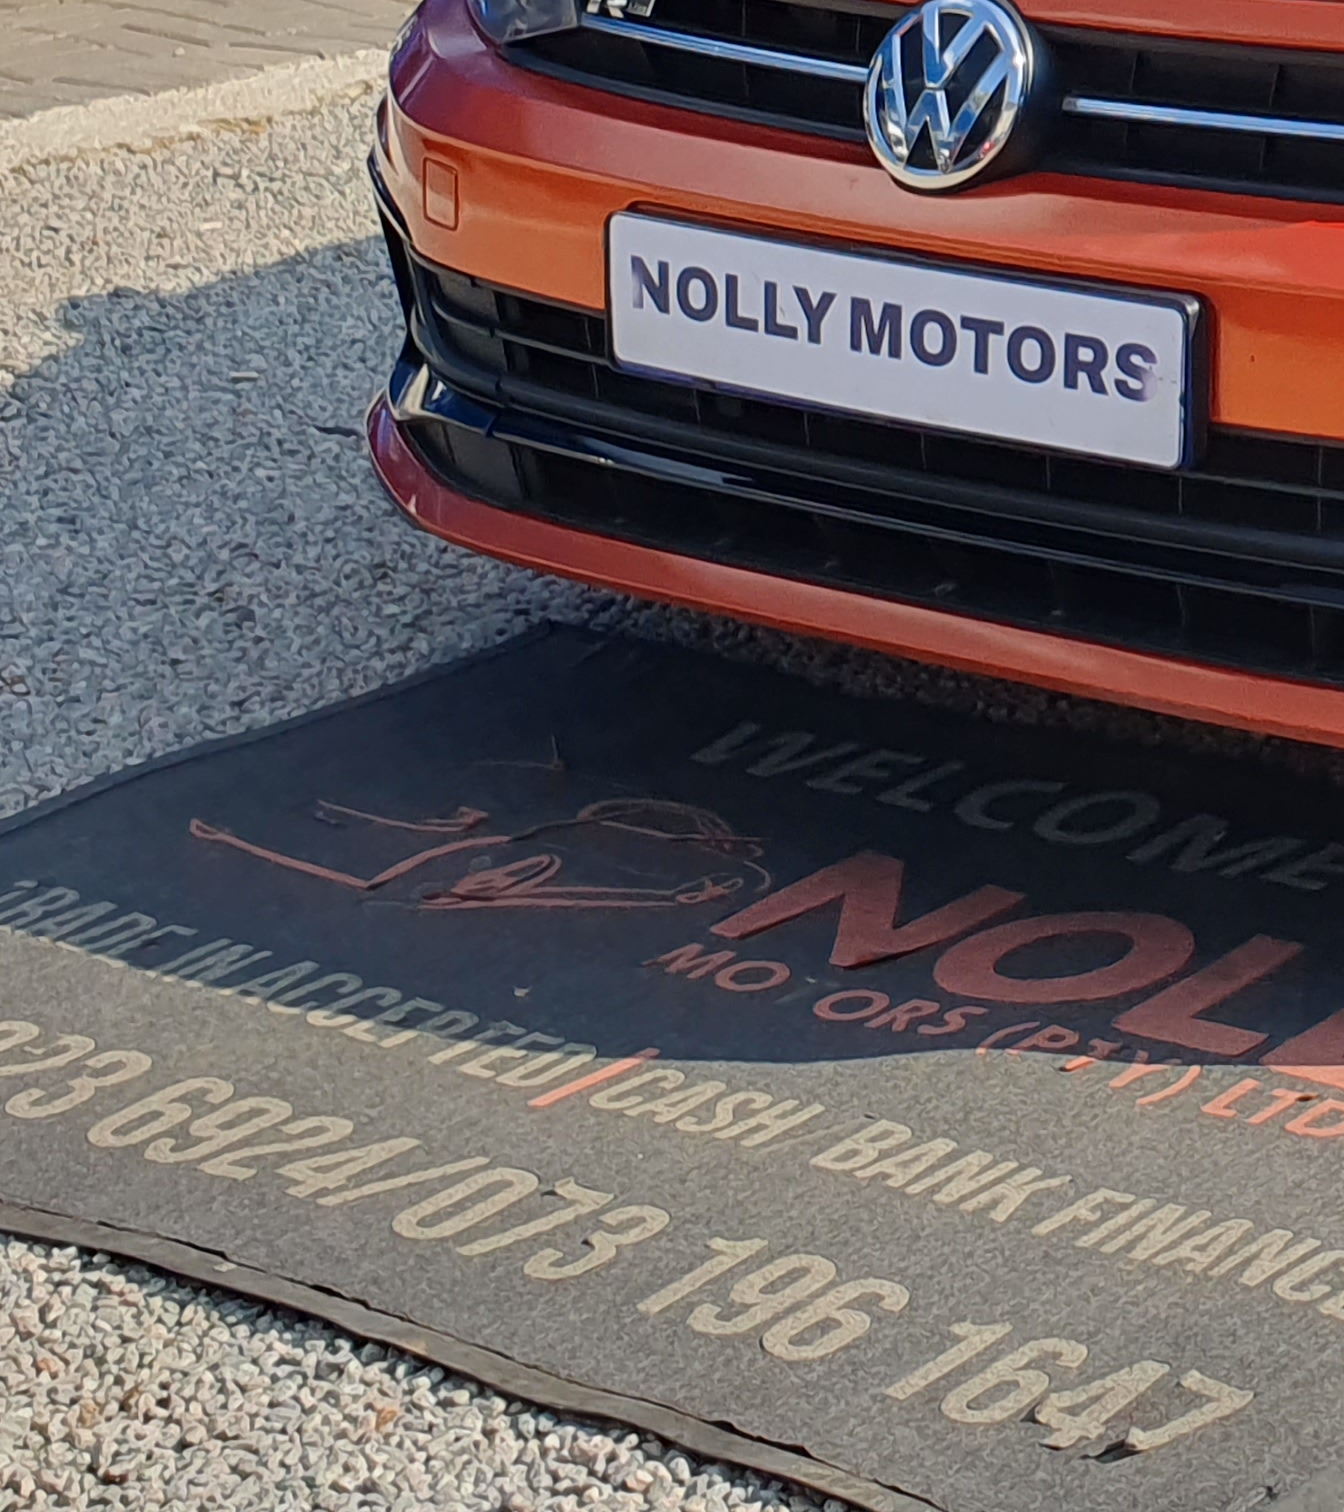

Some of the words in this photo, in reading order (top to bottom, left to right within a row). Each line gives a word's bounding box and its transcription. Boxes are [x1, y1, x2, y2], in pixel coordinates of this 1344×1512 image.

[629, 255, 837, 346] NOLLY
[849, 297, 1158, 403] MOTORS
[643, 942, 989, 1036] MOORS
[589, 1068, 826, 1148] CASH
[809, 1119, 1074, 1223] BANK
[636, 1236, 910, 1362] 196
[884, 1319, 1256, 1453] 1647
